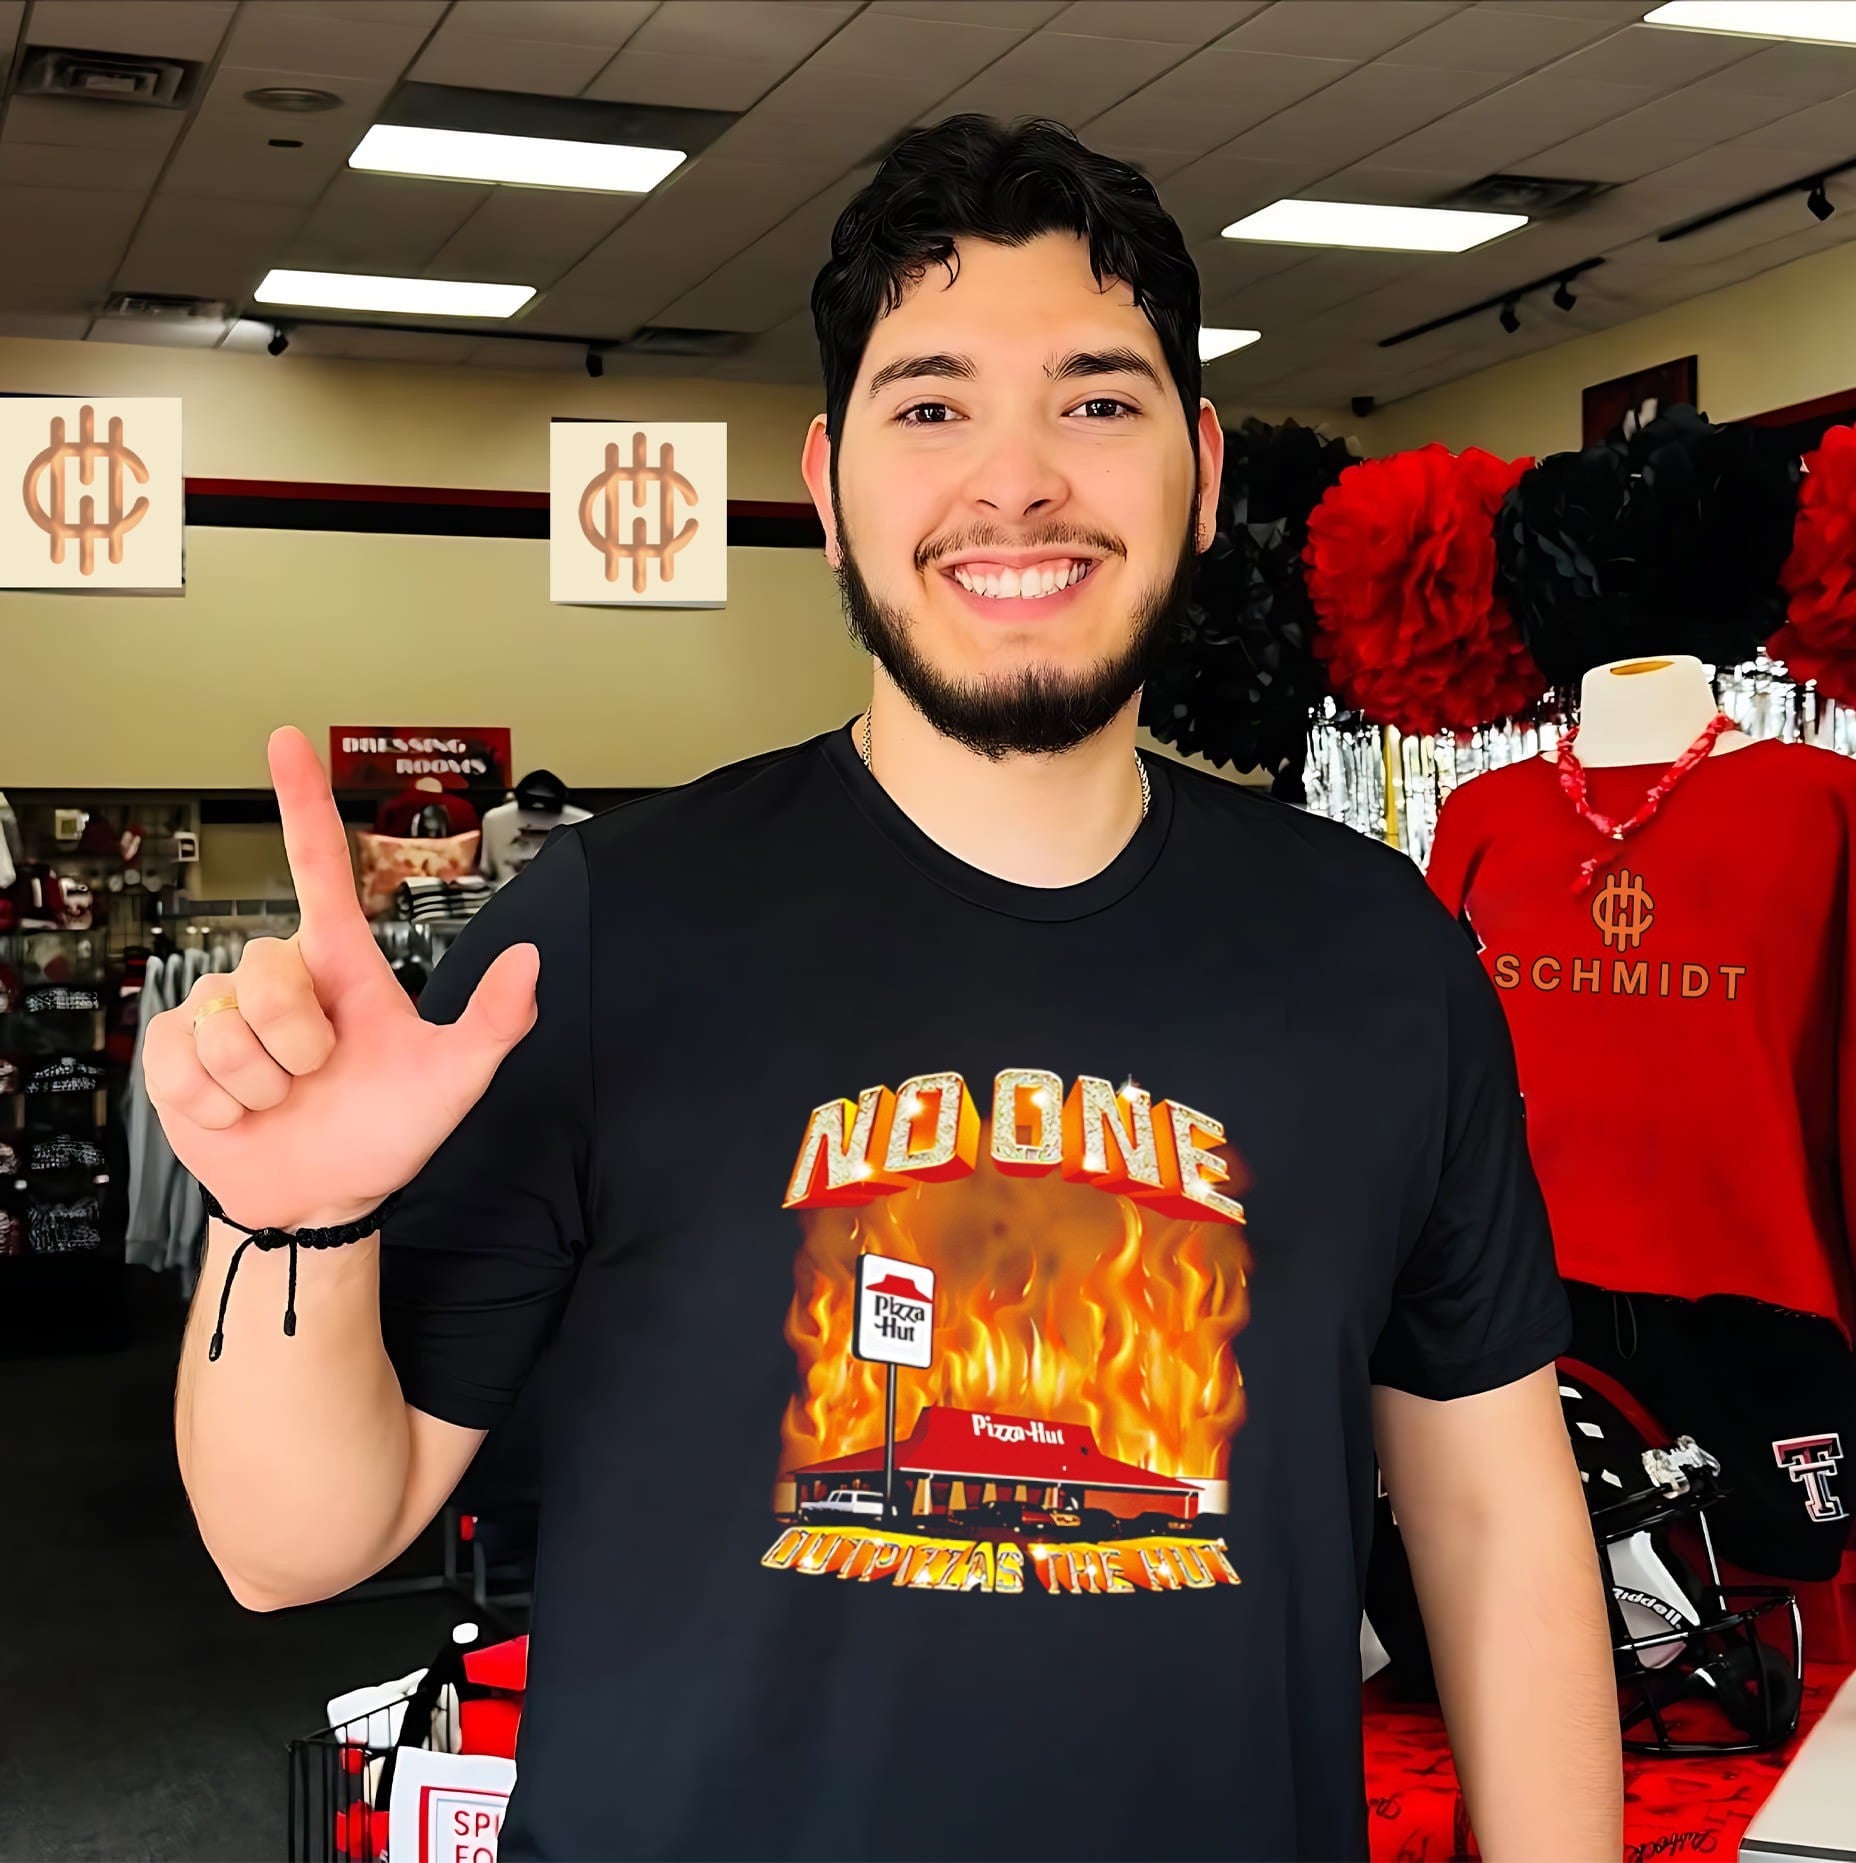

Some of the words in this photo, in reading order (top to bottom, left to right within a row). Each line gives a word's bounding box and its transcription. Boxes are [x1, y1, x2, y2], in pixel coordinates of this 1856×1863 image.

[342, 737, 467, 754] DRESSING
[396, 758, 487, 775] ROOMS
[1494, 954, 1746, 1000] SCHMIDT
[782, 1071, 977, 1208] NO
[990, 1068, 1247, 1225] ONE
[874, 1294, 926, 1323] Pizza
[874, 1315, 916, 1342] Hut
[971, 1413, 1025, 1443] Pizza
[1024, 1420, 1065, 1445] Hut
[760, 1527, 1025, 1594] OUTPIZZAS
[1040, 1544, 1135, 1595] THE
[1136, 1537, 1241, 1591] HUT
